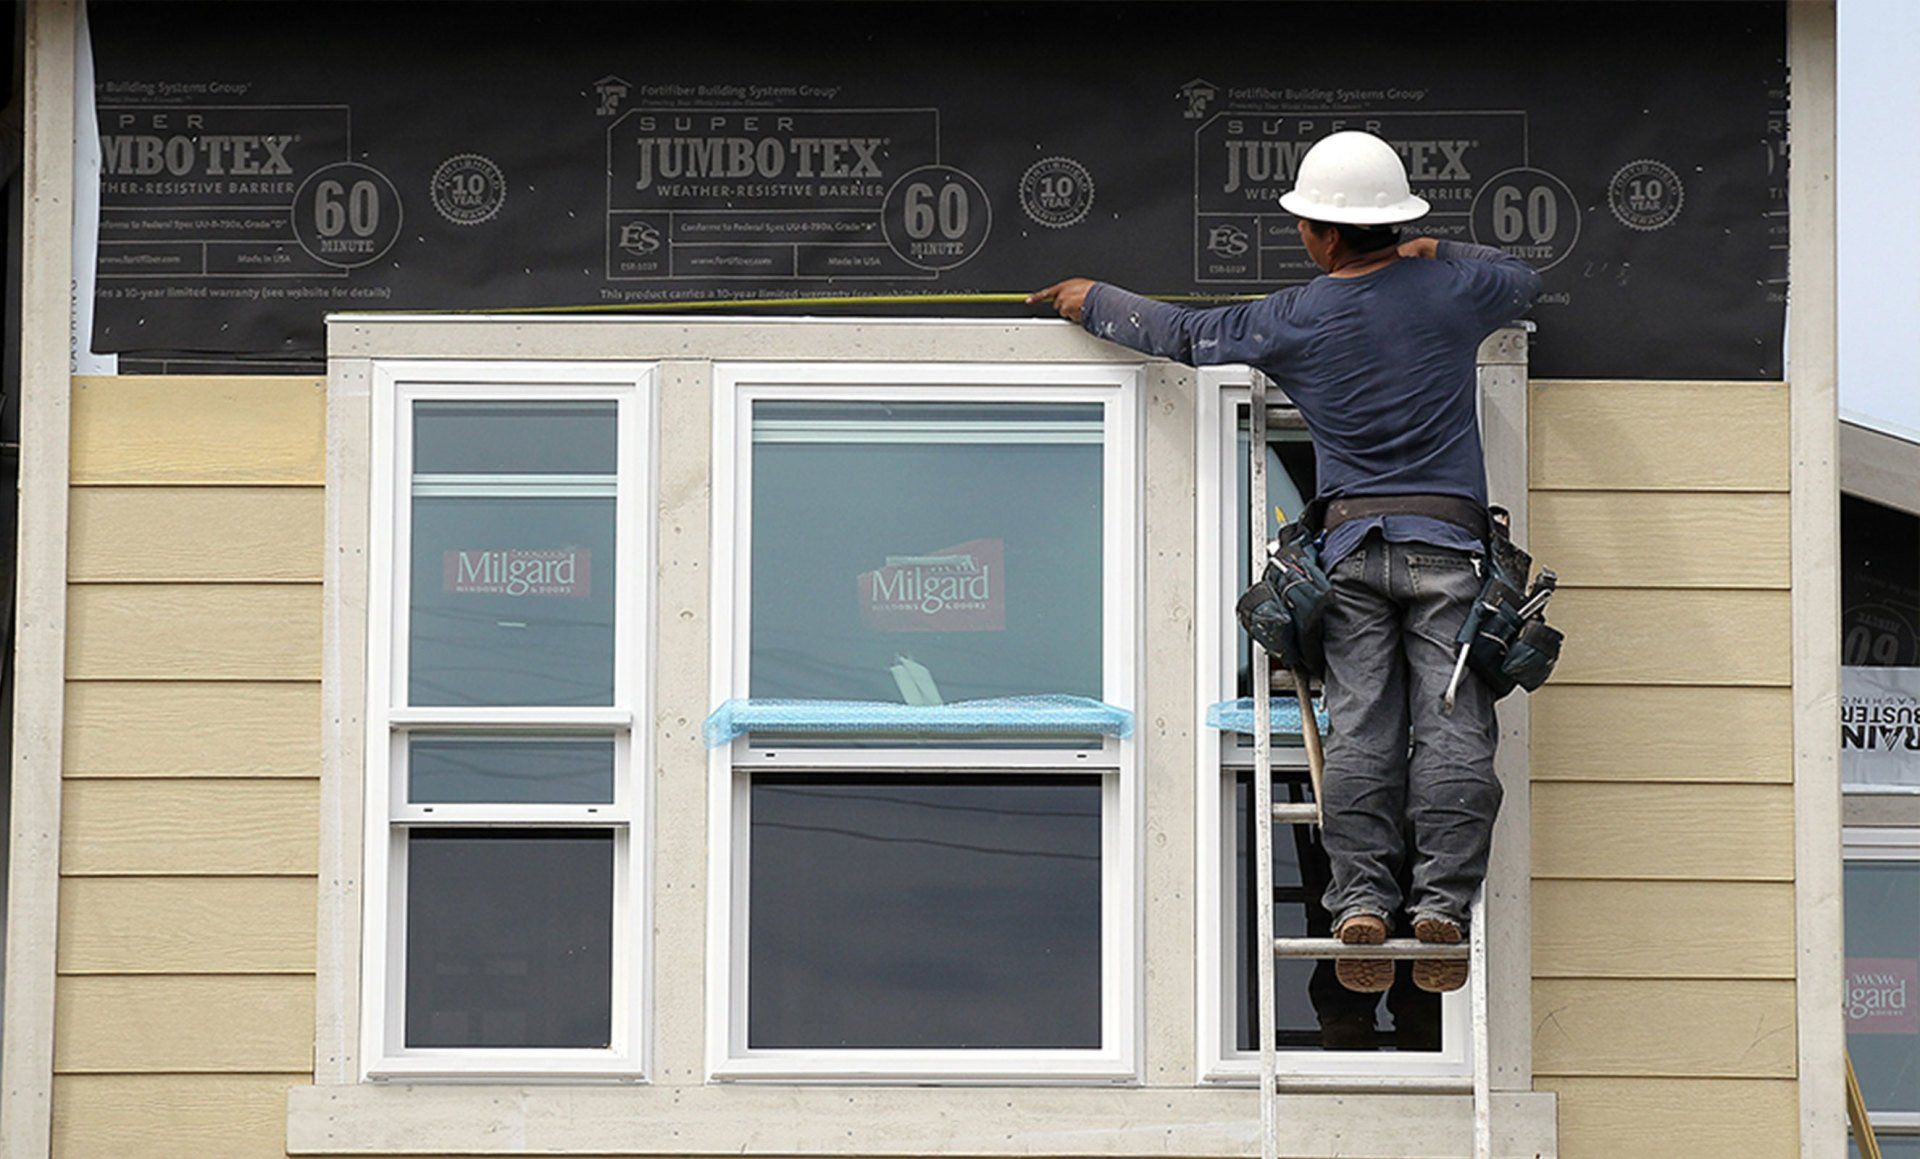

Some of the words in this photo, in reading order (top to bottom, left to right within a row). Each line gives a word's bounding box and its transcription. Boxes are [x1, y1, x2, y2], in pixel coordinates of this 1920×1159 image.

[158, 81, 206, 95] Systems
[640, 85, 695, 97] Fortifiber
[699, 85, 746, 99] Building
[750, 85, 797, 99] Systems
[1228, 87, 1282, 100] Fortifiber
[1286, 87, 1334, 103] Building
[1337, 87, 1384, 103] Systems
[640, 117, 794, 131] SUPER
[1228, 119, 1382, 135] SUPER
[200, 134, 294, 175] TEX
[636, 137, 785, 190] JUMBO
[790, 137, 882, 178] TEX
[1224, 140, 1313, 193] JUM
[228, 181, 295, 194] BARRIER
[452, 173, 485, 196] 10
[657, 184, 813, 197] WEATHER-RESISTIVE
[819, 184, 885, 197] BARRIER
[1041, 176, 1073, 198] 10
[1630, 179, 1663, 200] 10
[452, 195, 482, 205] YEAR
[1411, 188, 1474, 200] ARRIER
[315, 179, 380, 237] 60
[904, 182, 969, 239] 60
[1631, 200, 1661, 211] YEAR
[1493, 185, 1558, 243] 60
[321, 239, 374, 253] MINUTE
[910, 241, 964, 255] MINUTE
[167, 285, 207, 297] limited
[210, 287, 260, 299] warranty
[331, 286, 347, 298] for
[601, 287, 622, 299] This
[625, 287, 666, 301] product
[669, 286, 705, 299] carries
[457, 551, 576, 596] Milgard
[872, 564, 989, 614] Milgard
[1841, 724, 1920, 752] RAIN
